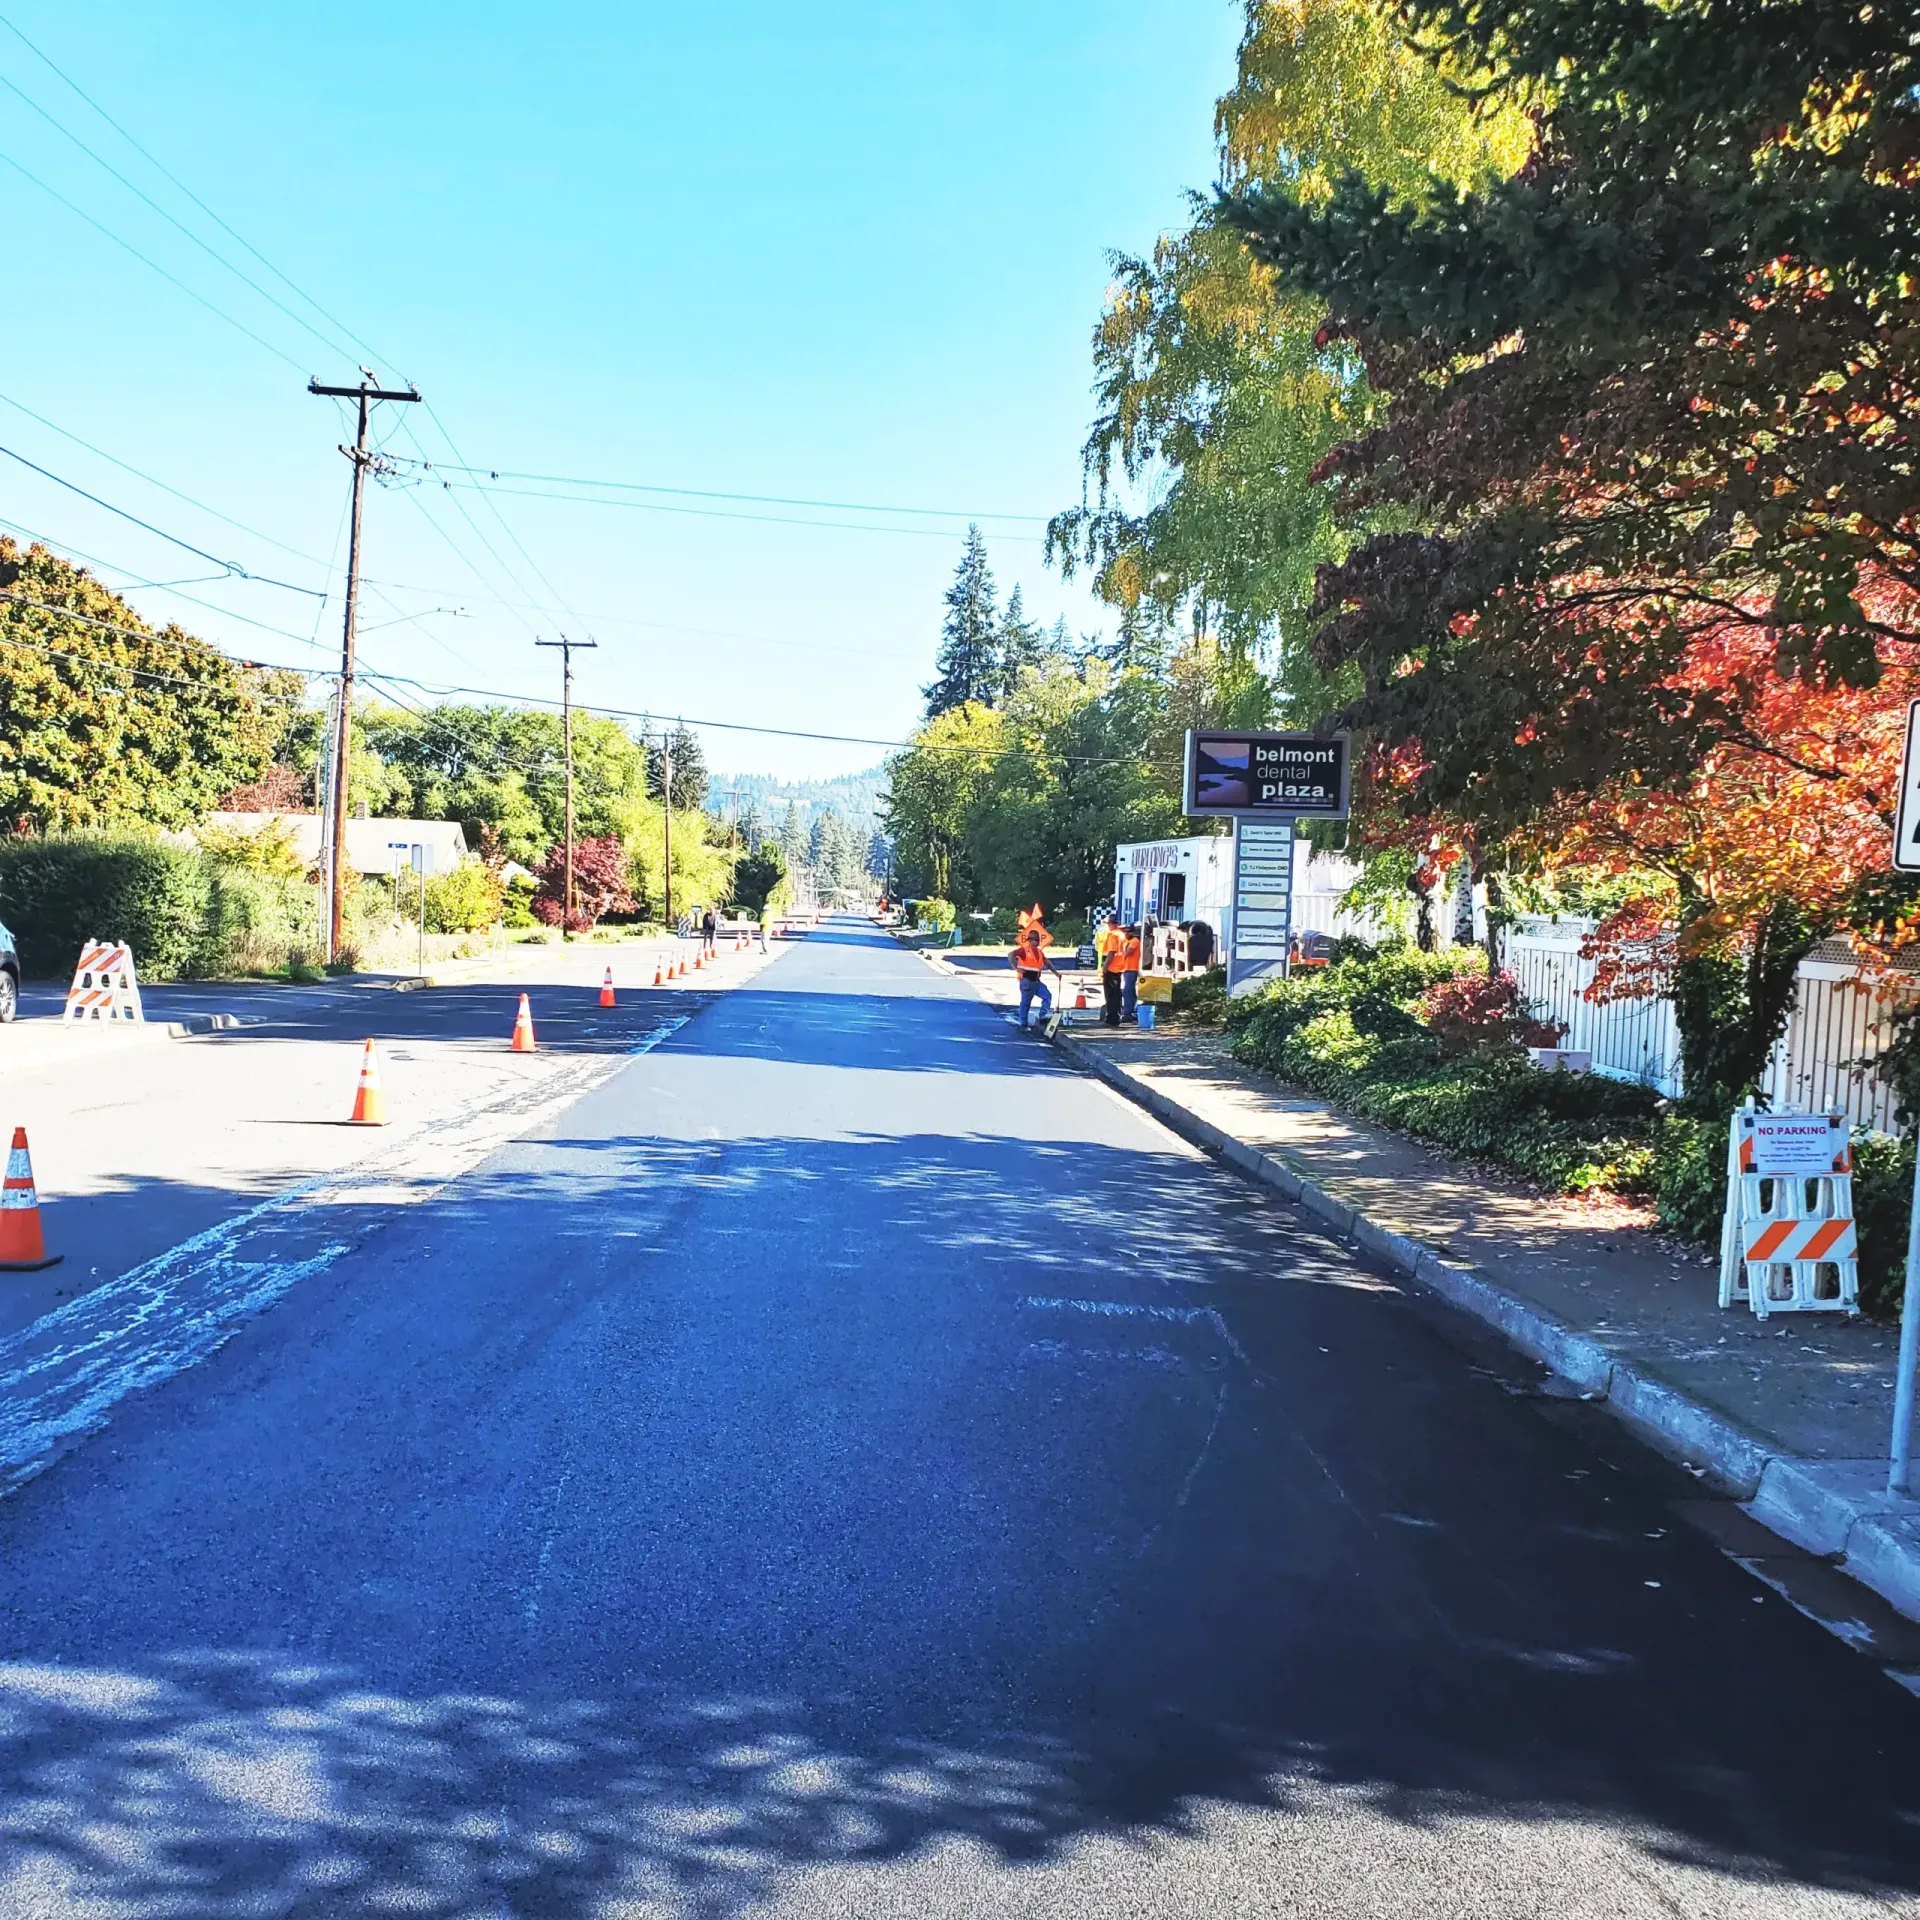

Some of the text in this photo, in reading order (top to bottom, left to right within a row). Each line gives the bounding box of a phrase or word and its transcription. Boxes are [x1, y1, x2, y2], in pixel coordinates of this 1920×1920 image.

[1256, 746, 1335, 763] belmont
[1257, 764, 1310, 779] dental
[1021, 934, 1047, 943] BP
[1758, 1126, 1827, 1135] NO PARKING
